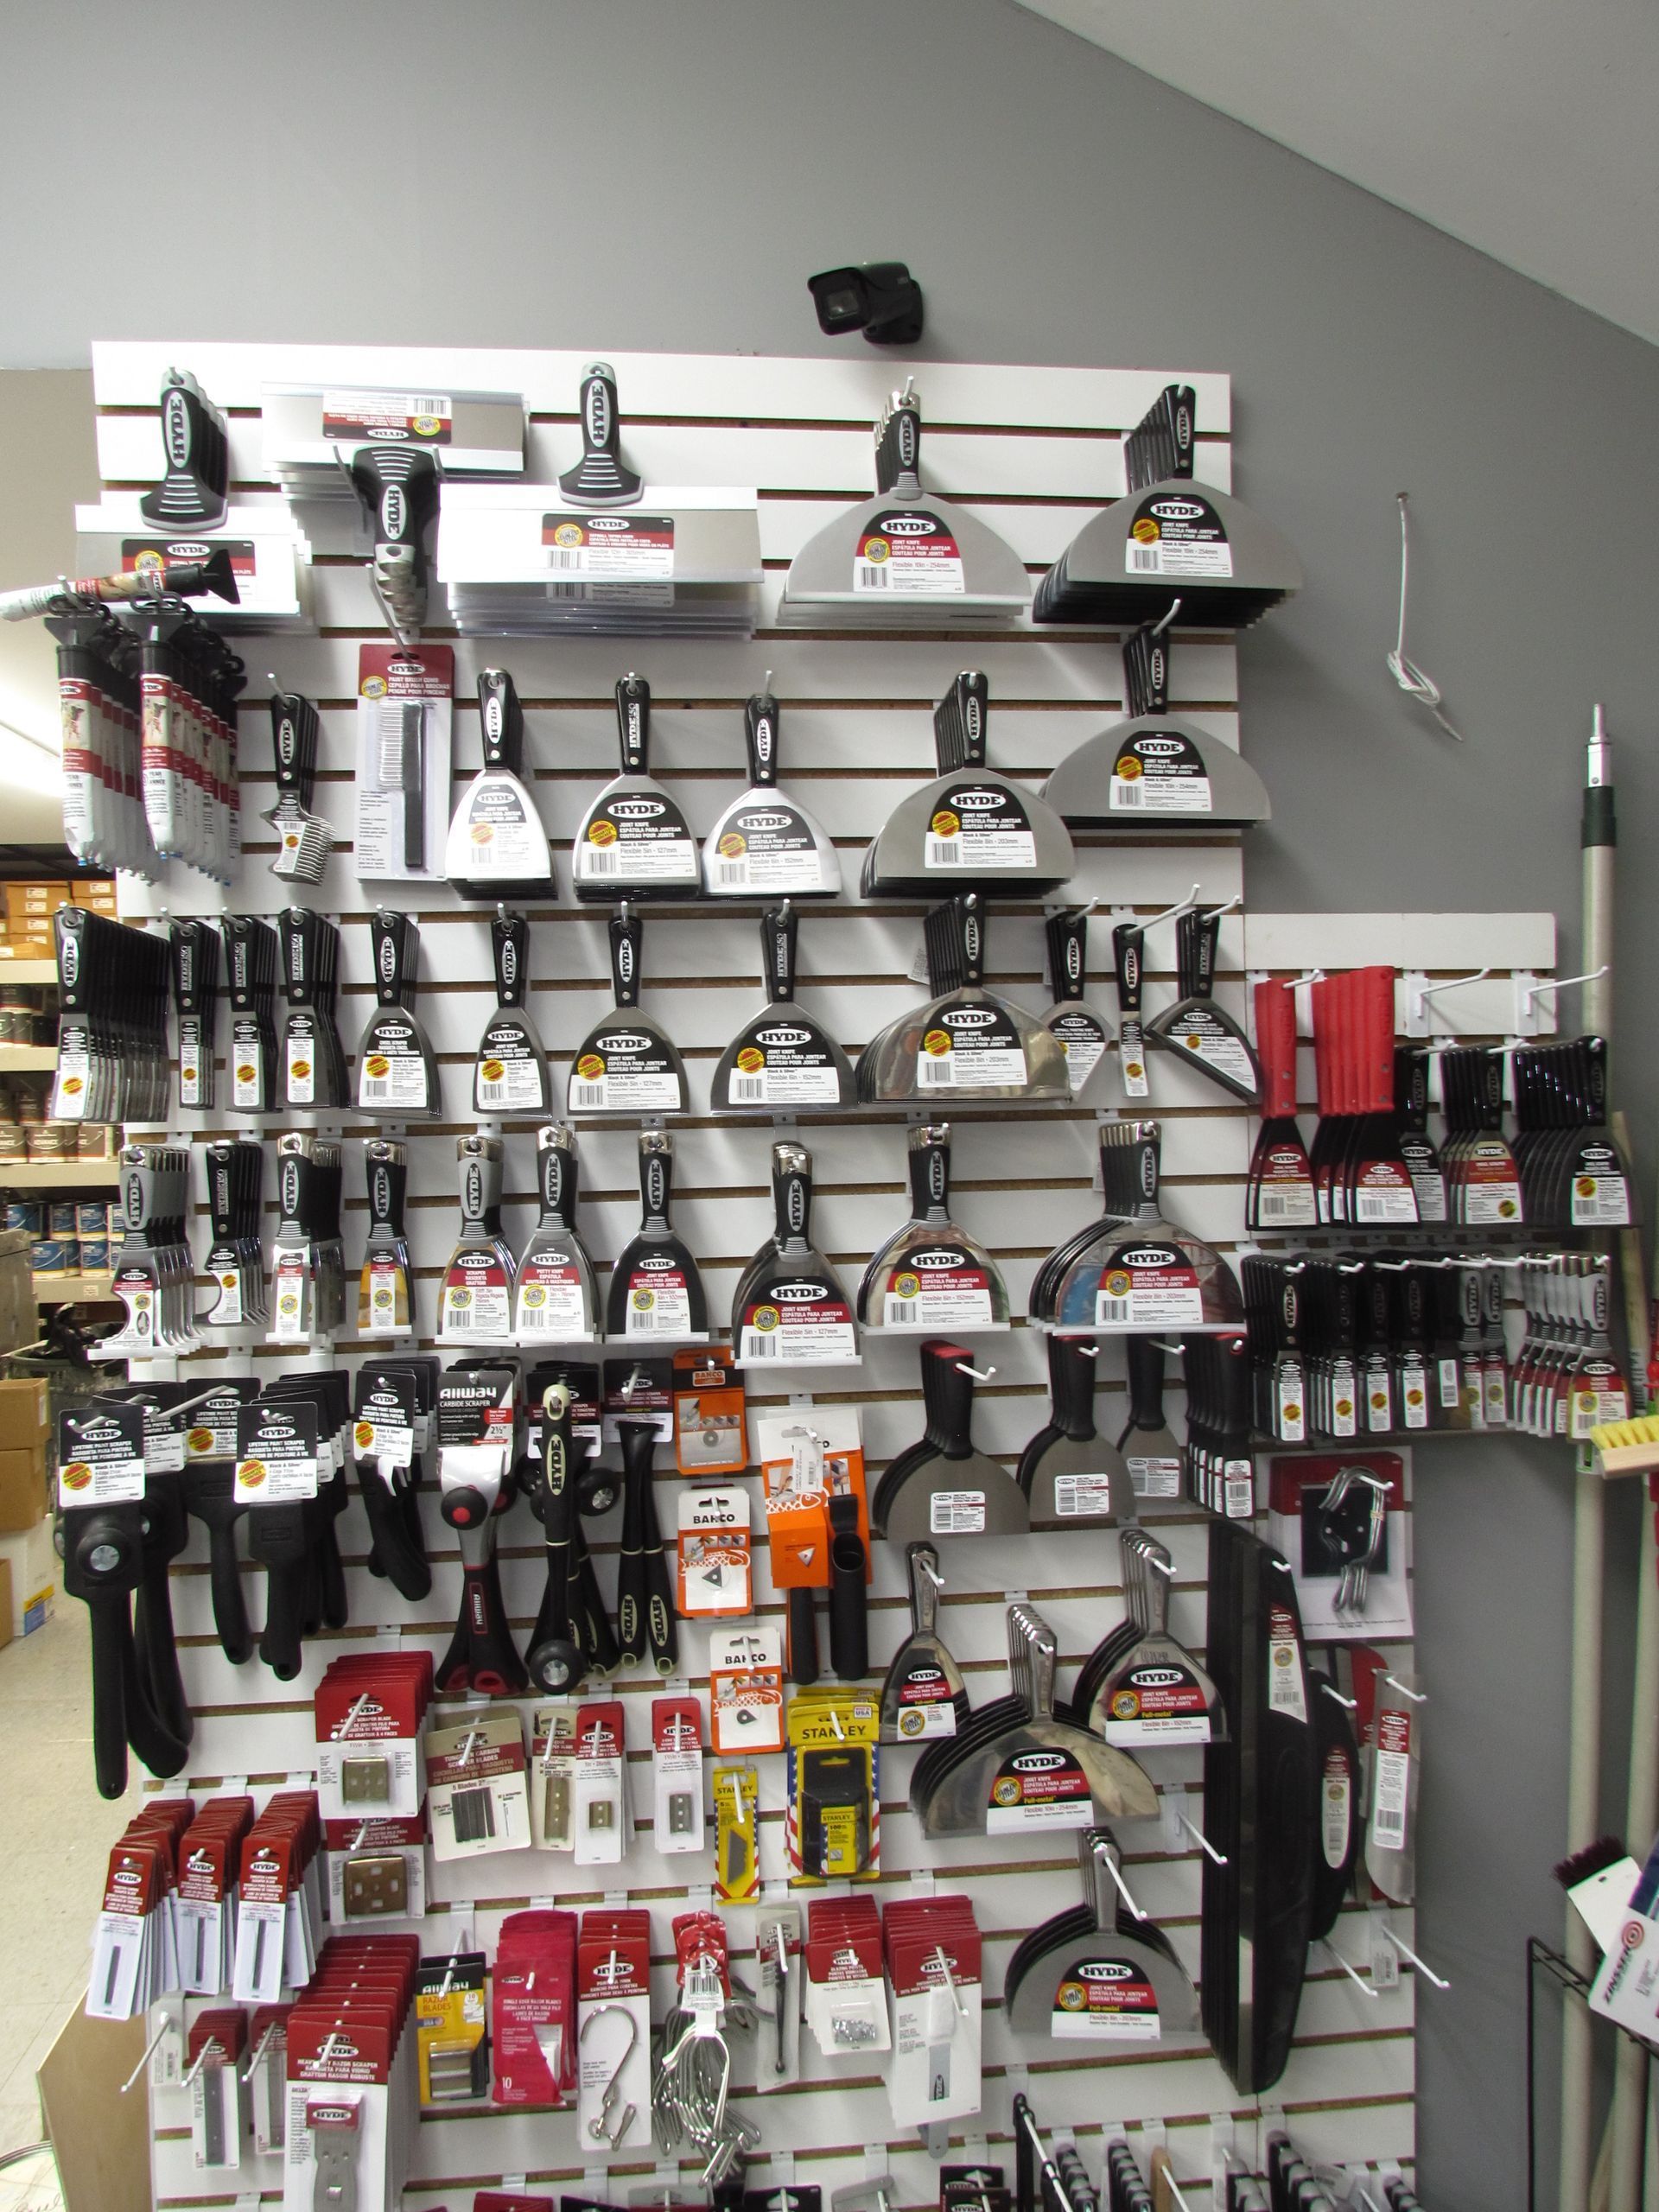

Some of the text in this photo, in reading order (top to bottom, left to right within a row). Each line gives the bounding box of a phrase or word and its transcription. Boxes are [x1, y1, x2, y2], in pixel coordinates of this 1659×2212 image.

[593, 385, 605, 441] HYDE
[172, 397, 183, 461] HYDE
[389, 490, 399, 534] HYDE
[1156, 506, 1199, 516] HYDE
[887, 523, 931, 531] HYDE
[1139, 742, 1180, 753] HYDE
[956, 795, 1001, 806] HYDE
[613, 805, 660, 814] HYDE
[743, 817, 786, 826] HYDE
[968, 919, 976, 957] HYDE
[947, 1014, 992, 1023] HYDE
[761, 1033, 806, 1042] HYDE
[602, 1039, 646, 1048] HYDE
[550, 1158, 558, 1202] HYDE
[287, 1165, 296, 1211] HYDE
[470, 1166, 479, 1211] HYDE
[130, 1178, 140, 1223] HYDE
[917, 1256, 960, 1265] HYDE
[777, 1288, 823, 1298] HYDE
[1470, 1278, 1478, 1319] HYDE
[1286, 1288, 1294, 1326] HYDE
[1597, 1281, 1607, 1325] HYDE
[262, 1428, 292, 1437] HYDE
[551, 1439, 562, 1490] HYDE
[624, 1599, 632, 1639] HYDE
[654, 1598, 665, 1641] HYDE
[1135, 1672, 1179, 1681] HYDE
[1018, 1758, 1062, 1767] HYDE
[118, 1873, 140, 1882] HYDE
[1082, 1967, 1128, 1977] HYDE
[423, 2003, 451, 2012] BLADES
[502, 2077, 512, 2088] 10
